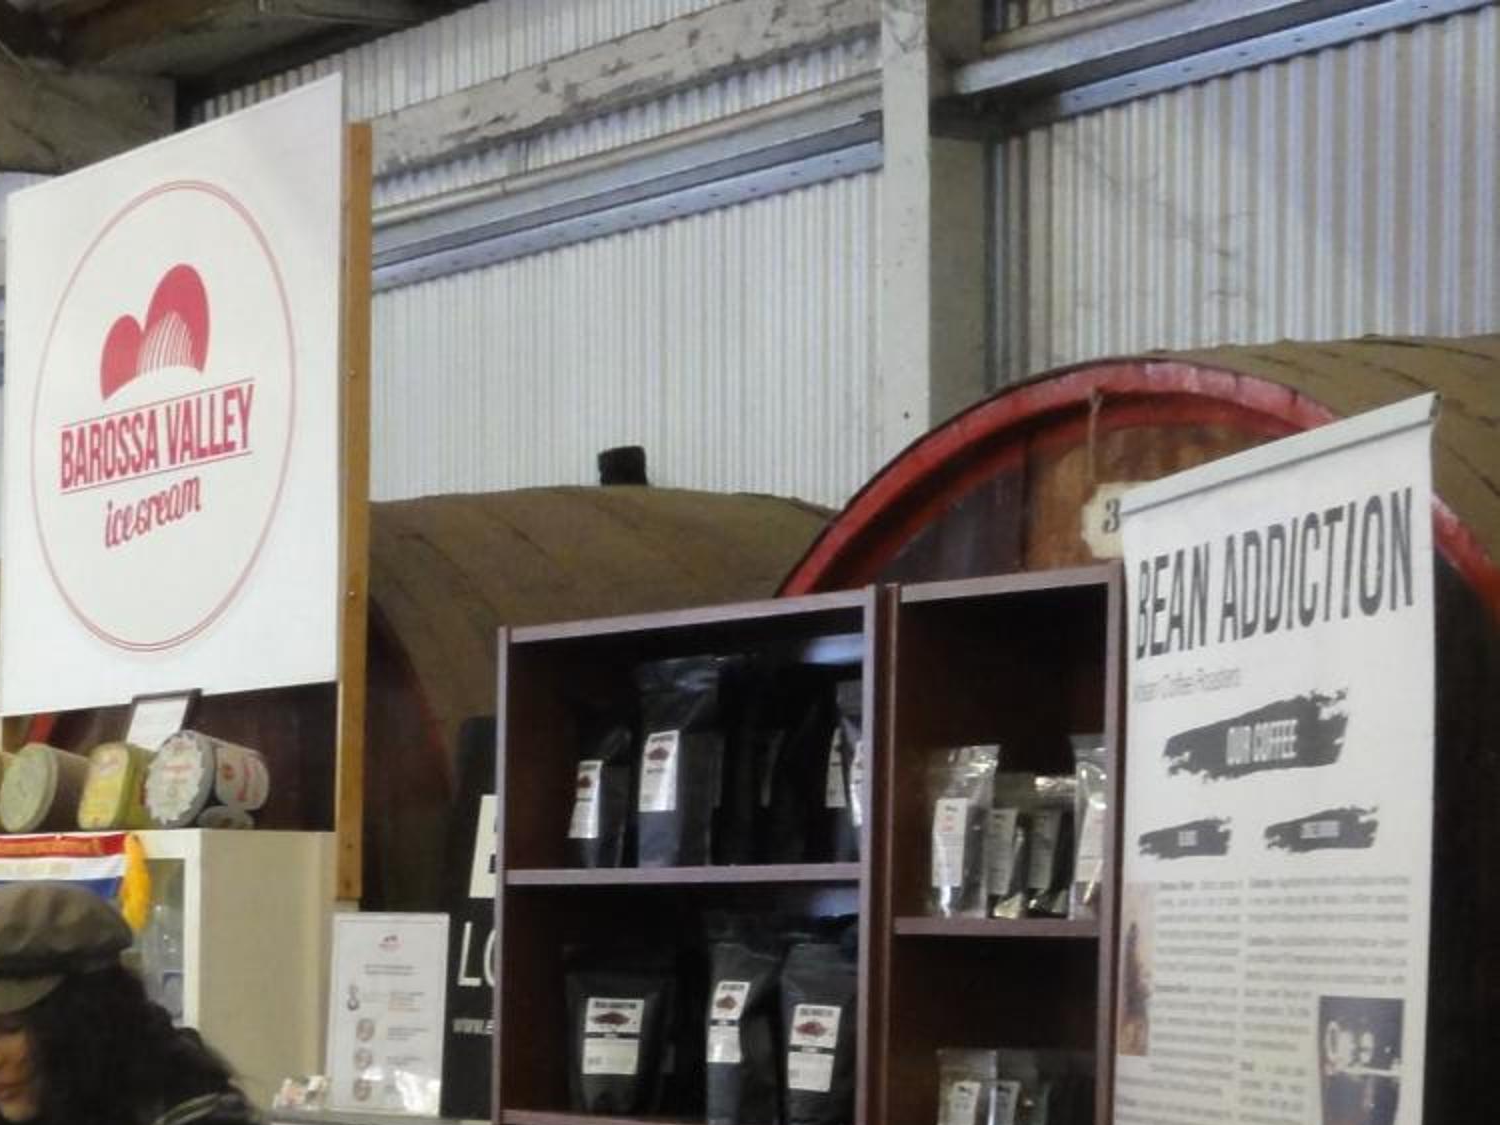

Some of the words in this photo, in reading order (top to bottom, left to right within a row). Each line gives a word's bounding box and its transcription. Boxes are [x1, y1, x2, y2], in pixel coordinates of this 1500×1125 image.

[61, 406, 159, 489] BAROSSA
[164, 383, 254, 466] VALLEY
[1136, 542, 1210, 660] BEAN
[1219, 487, 1414, 643] ADDICTION
